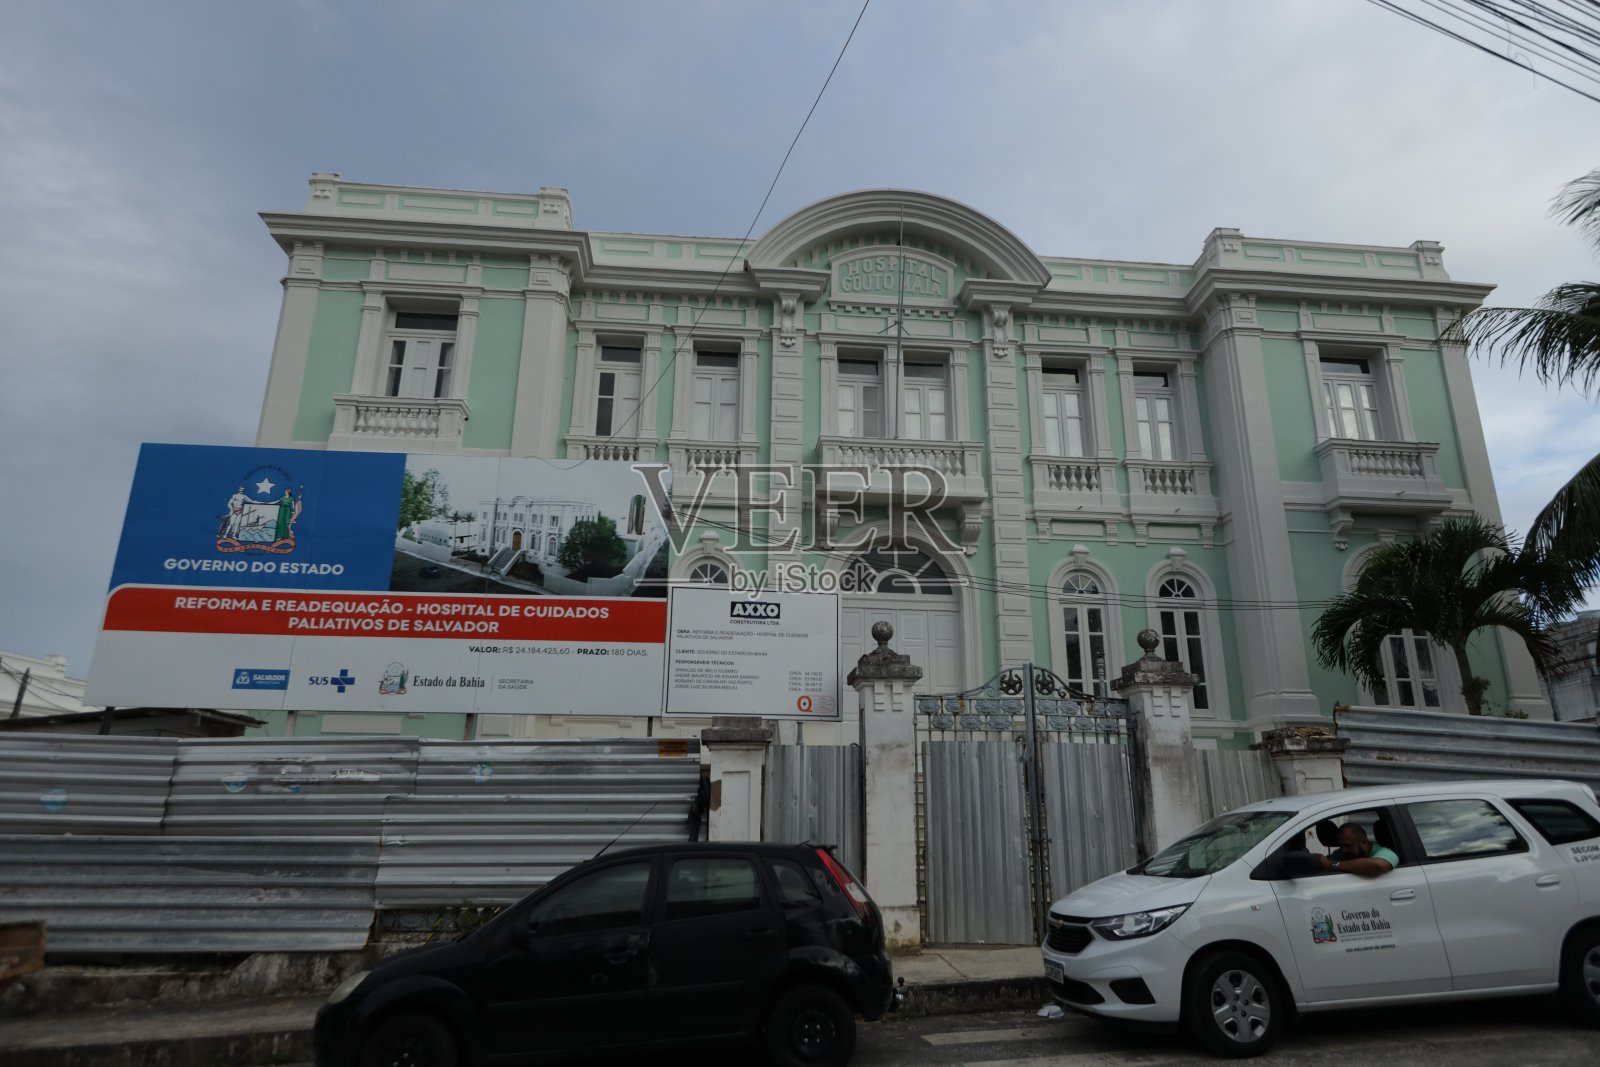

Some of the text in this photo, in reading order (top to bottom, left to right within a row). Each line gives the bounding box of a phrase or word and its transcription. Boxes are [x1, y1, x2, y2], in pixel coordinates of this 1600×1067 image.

[847, 255, 941, 284] HOSPITAL
[841, 273, 895, 293] COUTO
[164, 558, 345, 575] GOVERNO DO ESTADO
[175, 597, 259, 611] REFORMA
[262, 599, 272, 611] E
[275, 599, 404, 617] READEQUAÇÃO
[416, 603, 495, 617] HOSPITAL
[498, 605, 521, 617] DE
[524, 605, 609, 619] CUIDADOS
[732, 603, 779, 617] AXXO
[288, 617, 499, 633] PALIATIVOS DE SALVADOR
[469, 645, 501, 654] VALOR:
[502, 646, 513, 654] R$
[515, 646, 570, 655] 24.184.425,60
[577, 648, 610, 656] PRAZO:
[627, 649, 649, 657] DIAS.
[308, 676, 329, 685] SUS
[413, 675, 486, 688] Estado da Bahia
[1571, 845, 1599, 854] SECOM
[1341, 907, 1380, 921] Governo do
[1337, 919, 1391, 934] Estado da Bahia
